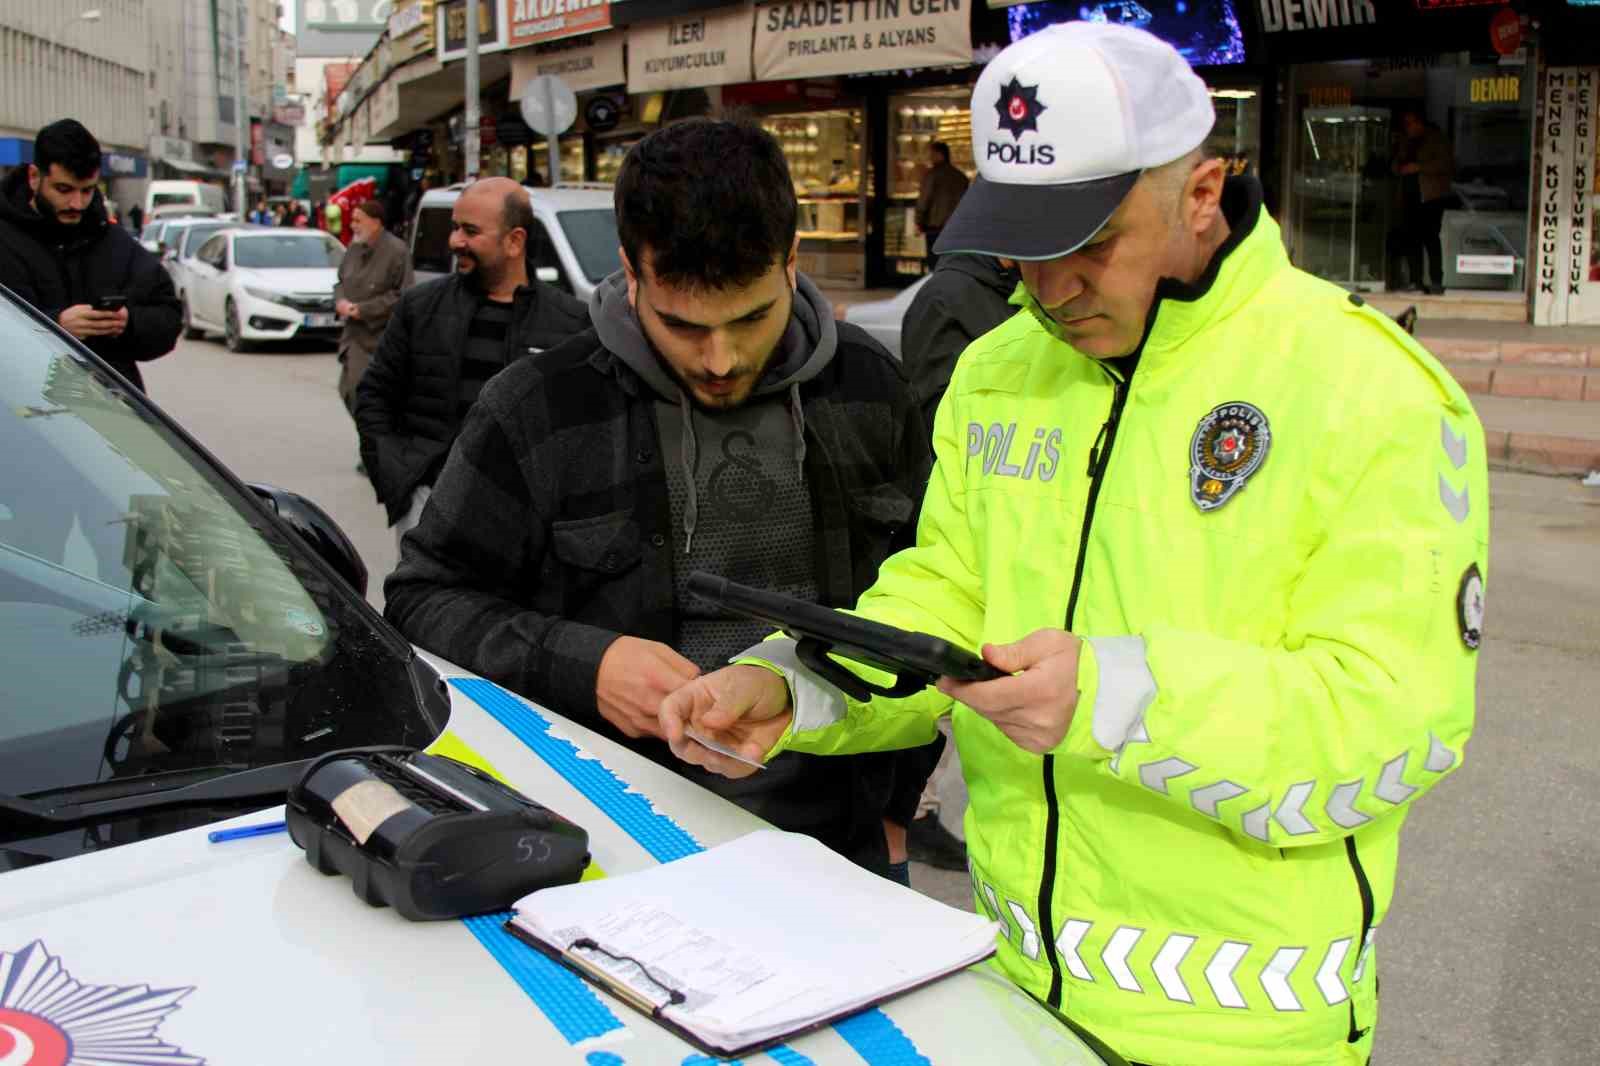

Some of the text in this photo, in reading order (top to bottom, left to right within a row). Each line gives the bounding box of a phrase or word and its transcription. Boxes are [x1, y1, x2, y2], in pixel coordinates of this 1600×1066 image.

[787, 26, 936, 56] PIRLANTA & ALYANS
